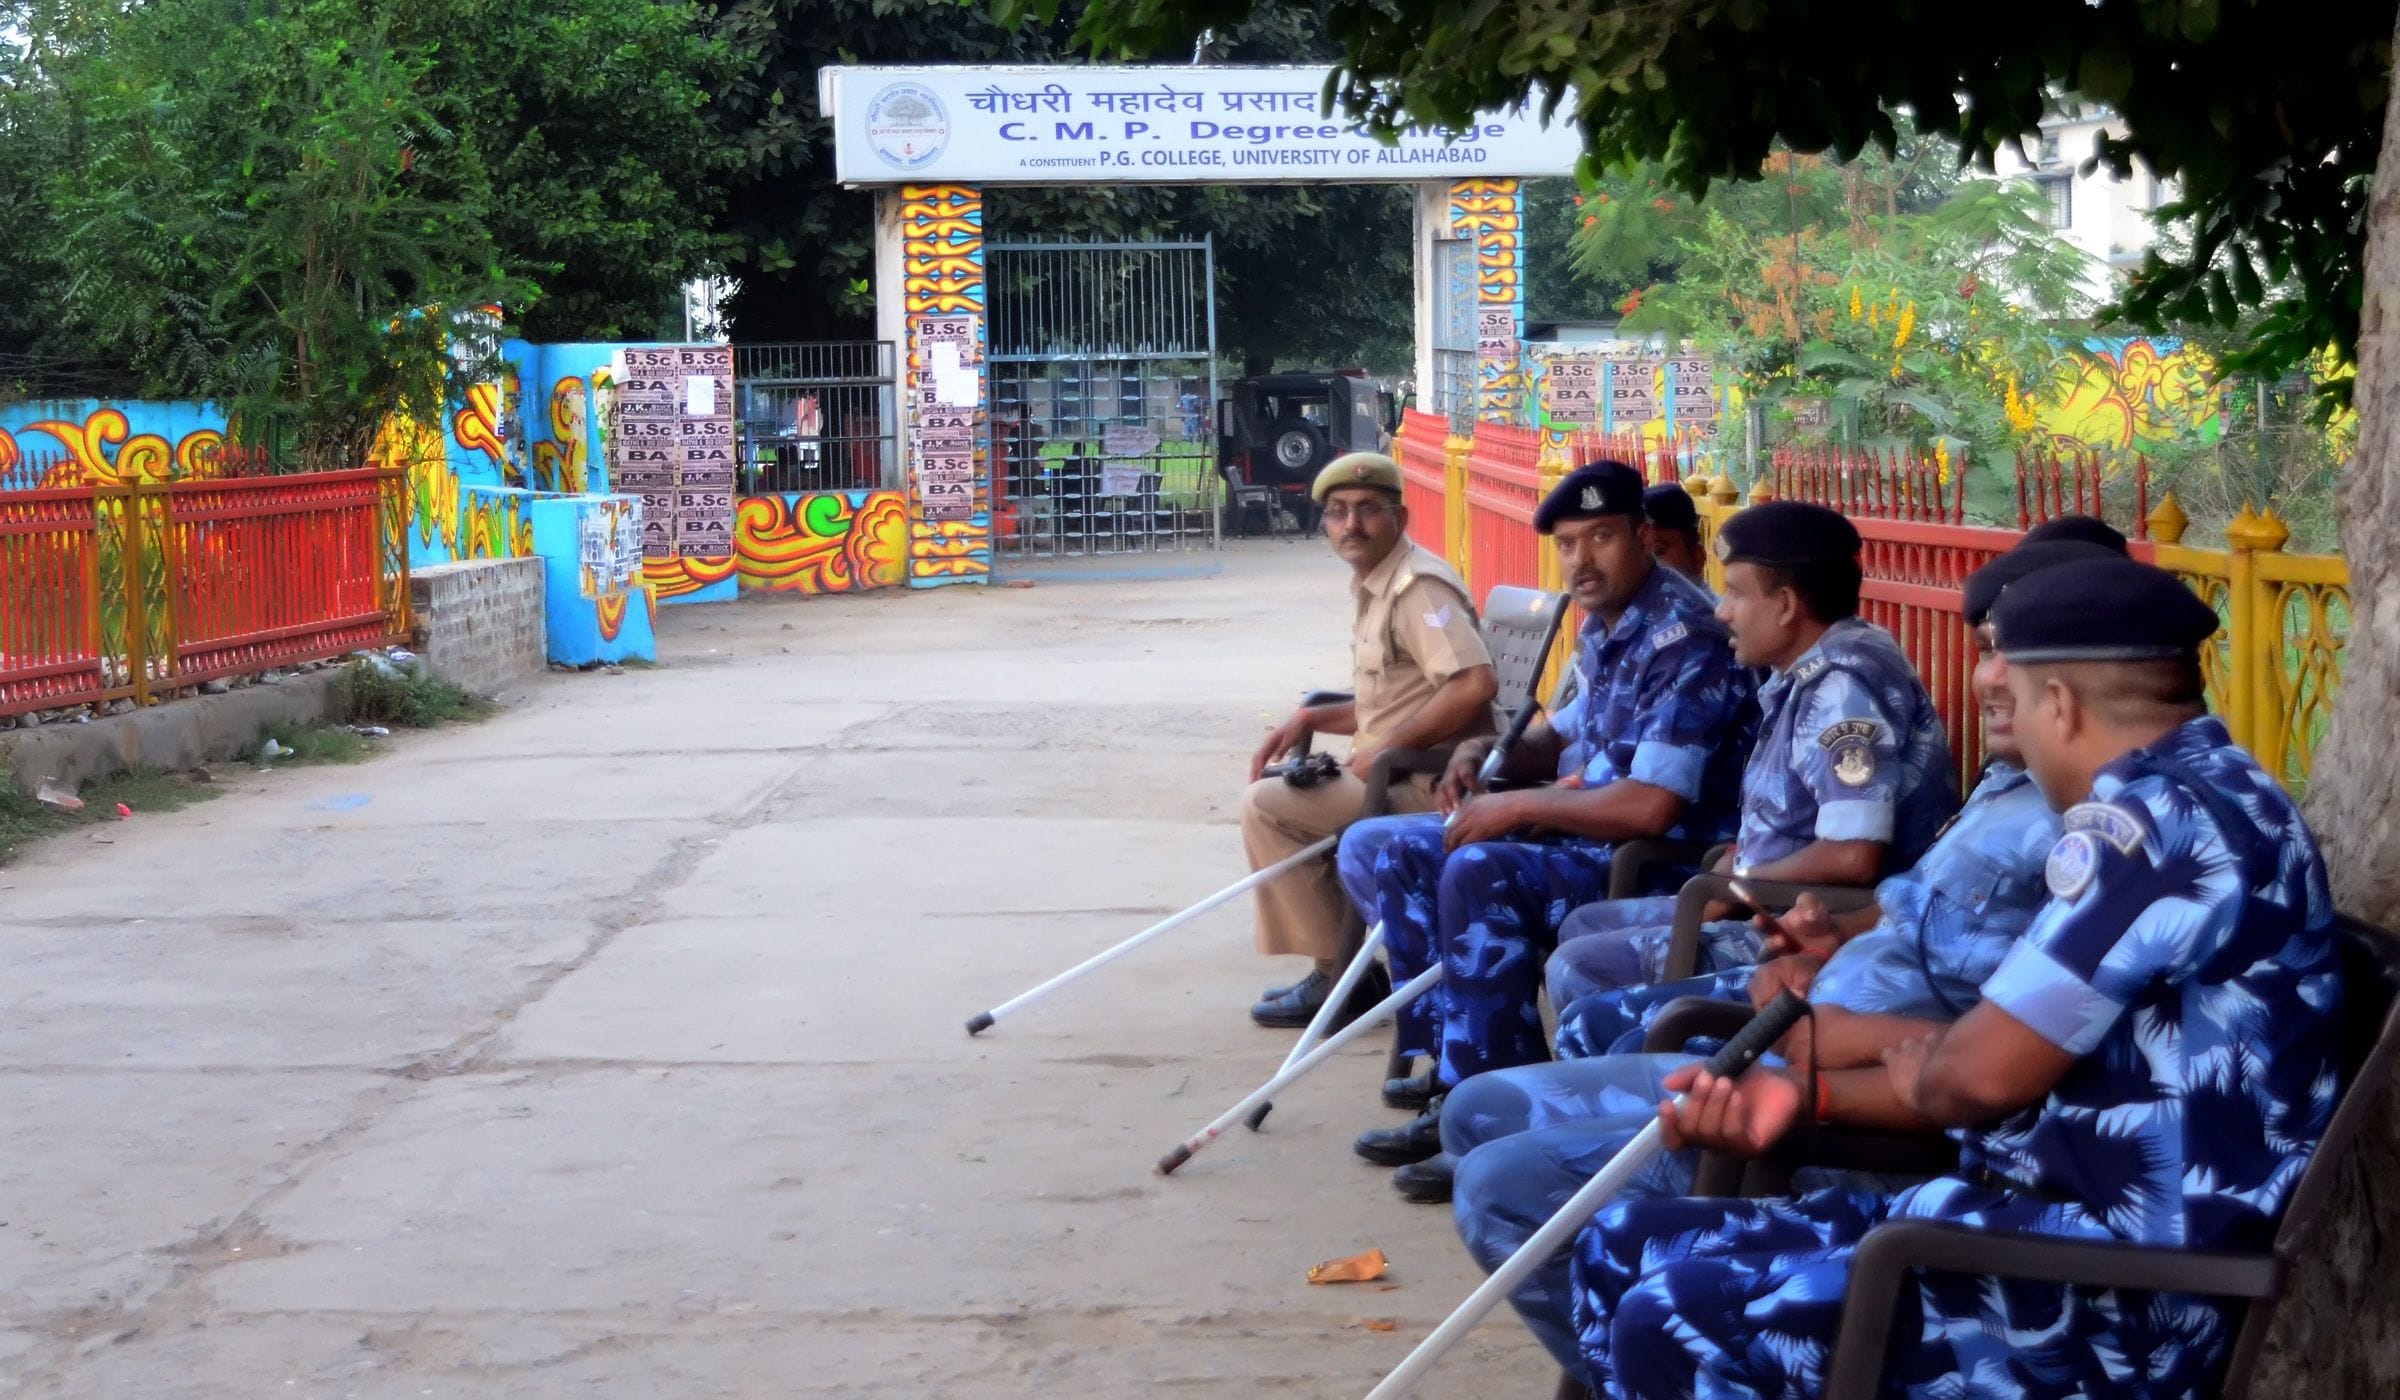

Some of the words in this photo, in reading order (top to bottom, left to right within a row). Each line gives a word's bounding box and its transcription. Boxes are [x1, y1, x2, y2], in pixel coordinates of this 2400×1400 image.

[965, 84, 1071, 114] चौधरी
[1086, 84, 1203, 115] महादेव
[1218, 92, 1317, 113] प्रसाद
[999, 122, 1037, 141] C.
[1056, 122, 1107, 140] M.
[1125, 122, 1160, 140] P.
[1192, 120, 1338, 144] Degree
[1020, 158, 1026, 167] A
[1030, 158, 1096, 167] CONSTITUENT
[1100, 151, 1135, 167] P.G.
[1142, 150, 1226, 168] COLLEGE,
[1233, 150, 1340, 166] UNIVERSITY
[1347, 150, 1370, 165] OF
[1376, 148, 1486, 164] ALLAHABAD
[1480, 314, 1508, 325] .Sc
[922, 323, 967, 336] B.Sc
[626, 353, 671, 366] B.Sc
[682, 353, 728, 365] B.Sc
[1552, 366, 1593, 377] B.Sc
[628, 380, 668, 390] BA
[1557, 391, 1590, 400] BA
[1613, 389, 1647, 398] BA
[1675, 387, 1707, 396] BA
[928, 418, 965, 428] BA
[624, 424, 672, 436] B.Sc
[683, 423, 729, 435] B.Sc
[629, 451, 668, 460] BA
[688, 450, 727, 460] BA
[924, 459, 968, 470] B.Sc
[929, 485, 965, 494] BA
[643, 495, 669, 507] Sc
[681, 494, 728, 506] B.Sc
[645, 522, 664, 532] A
[686, 522, 725, 532] BA
